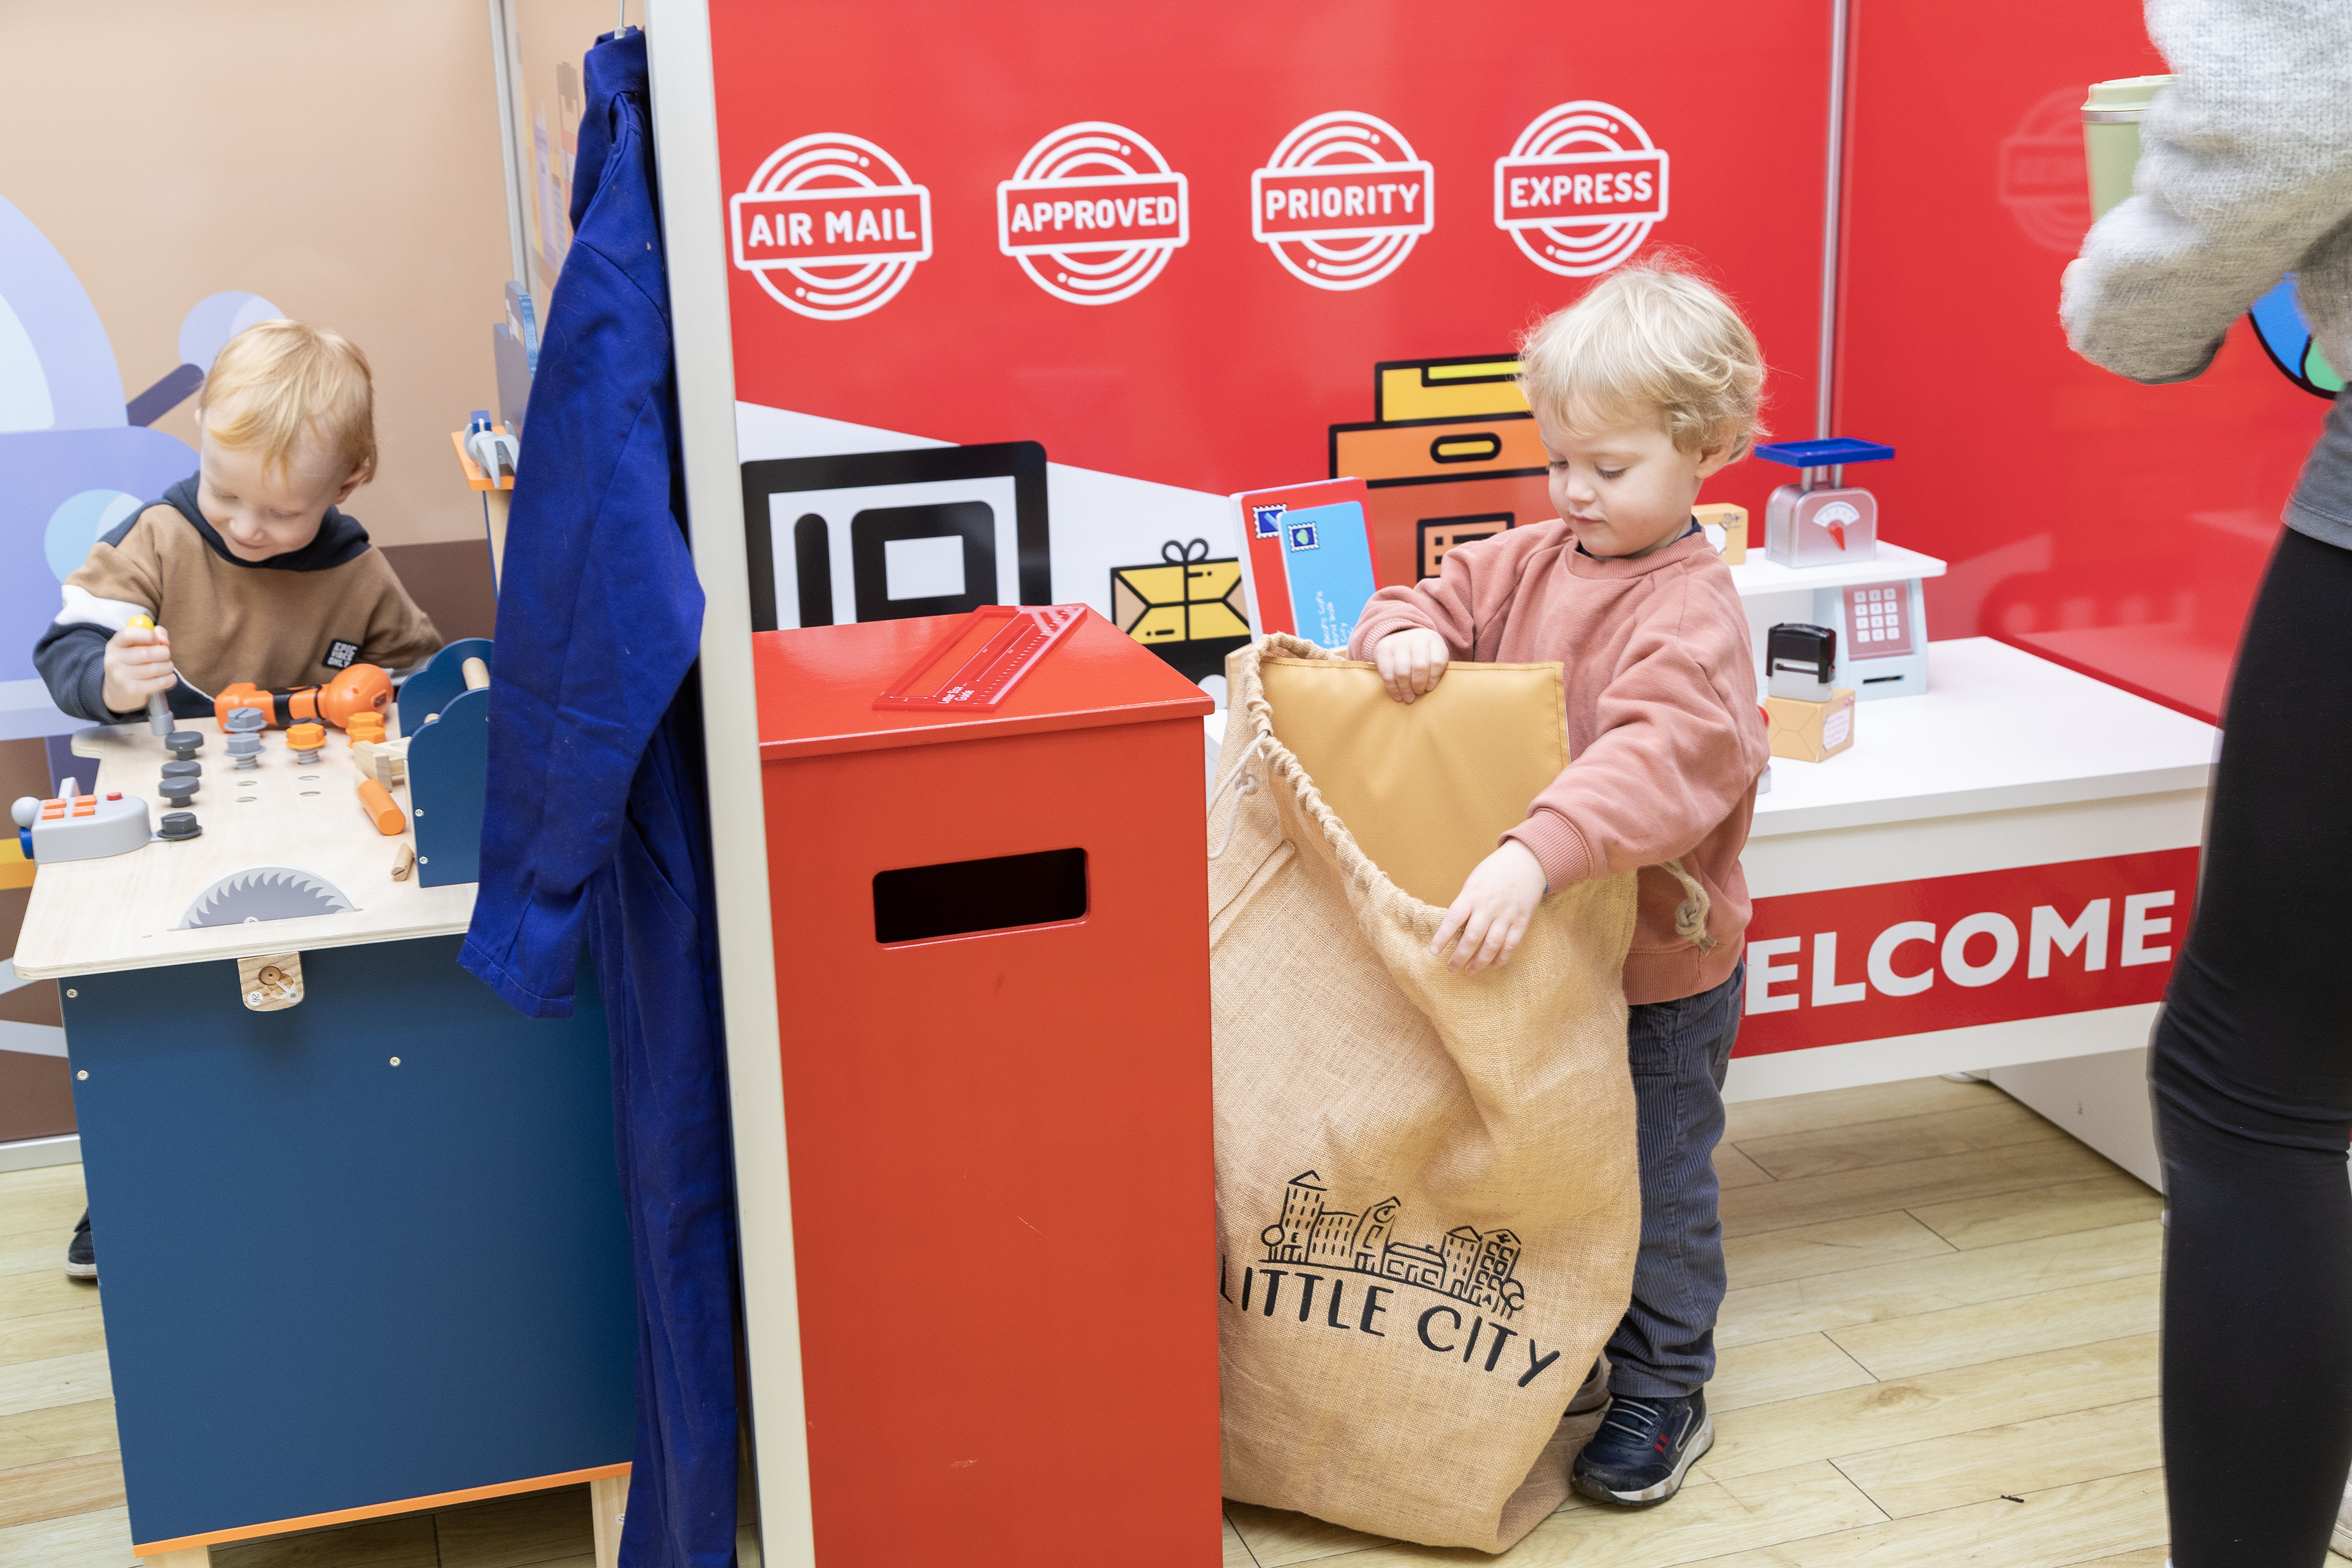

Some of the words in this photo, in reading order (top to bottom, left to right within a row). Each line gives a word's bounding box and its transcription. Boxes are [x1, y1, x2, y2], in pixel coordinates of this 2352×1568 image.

[1266, 184, 1419, 220] PRIORITY
[1511, 171, 1652, 207] EXPRESS
[749, 213, 813, 247] AIR
[825, 208, 916, 243] MAIL
[1011, 197, 1176, 233] APPROVED
[333, 642, 357, 654] EPIC
[937, 694, 955, 704] Letter
[954, 690, 975, 701] Guide
[1744, 889, 2176, 1016] ELCOME
[1220, 1254, 1394, 1337] LITTLE
[1417, 1305, 1560, 1388] CITY
